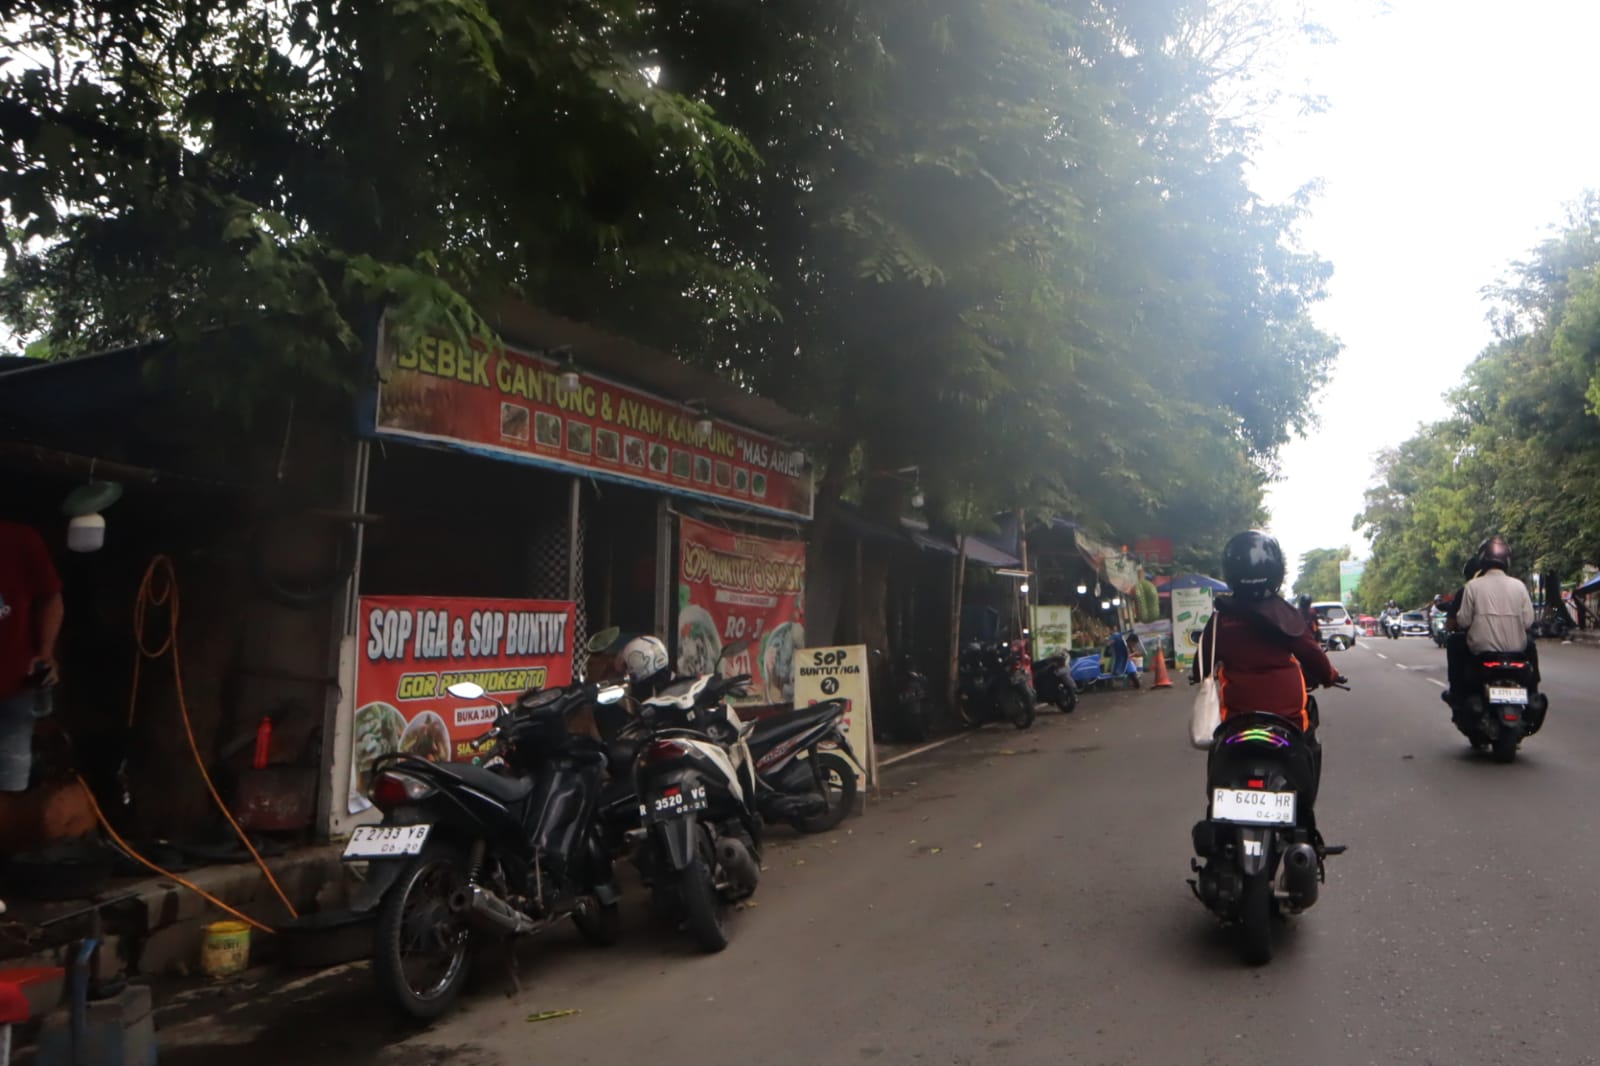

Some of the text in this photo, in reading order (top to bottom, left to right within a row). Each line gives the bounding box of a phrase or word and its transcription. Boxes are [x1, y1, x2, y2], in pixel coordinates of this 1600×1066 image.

[398, 335, 490, 388] BEBEK
[496, 359, 597, 417] GANTUNG
[600, 391, 613, 422] &
[617, 397, 663, 435] AYAM
[667, 415, 736, 458] KAMPUNG
[368, 608, 568, 660] SOP IGA & SOP BUNTUT
[813, 650, 847, 666] SOP
[800, 665, 860, 677] BUNTUT/IGA
[399, 675, 437, 699] GOR
[457, 708, 496, 722] BUKA JAM
[639, 803, 647, 817] R
[655, 793, 682, 811] 3520
[1217, 790, 1291, 807] R 6404 HR
